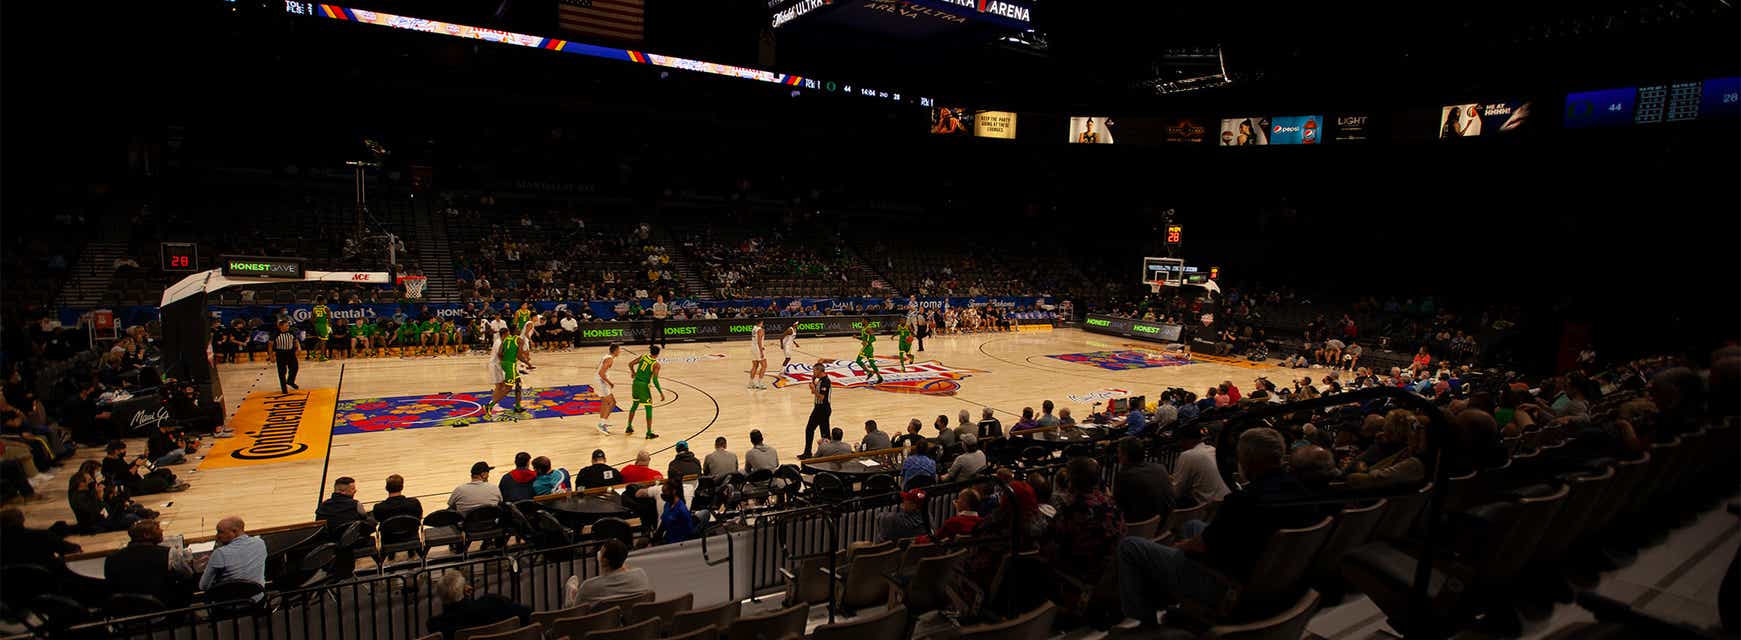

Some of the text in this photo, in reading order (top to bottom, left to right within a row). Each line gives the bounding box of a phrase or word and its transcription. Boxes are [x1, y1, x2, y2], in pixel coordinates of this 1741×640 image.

[990, 0, 1030, 22] ARENA
[1608, 103, 1623, 112] 44
[1337, 116, 1369, 126] LIGHT
[1282, 126, 1300, 134] pepsi
[171, 254, 189, 268] 28
[351, 273, 370, 284] ACE
[231, 399, 308, 460] Continental
